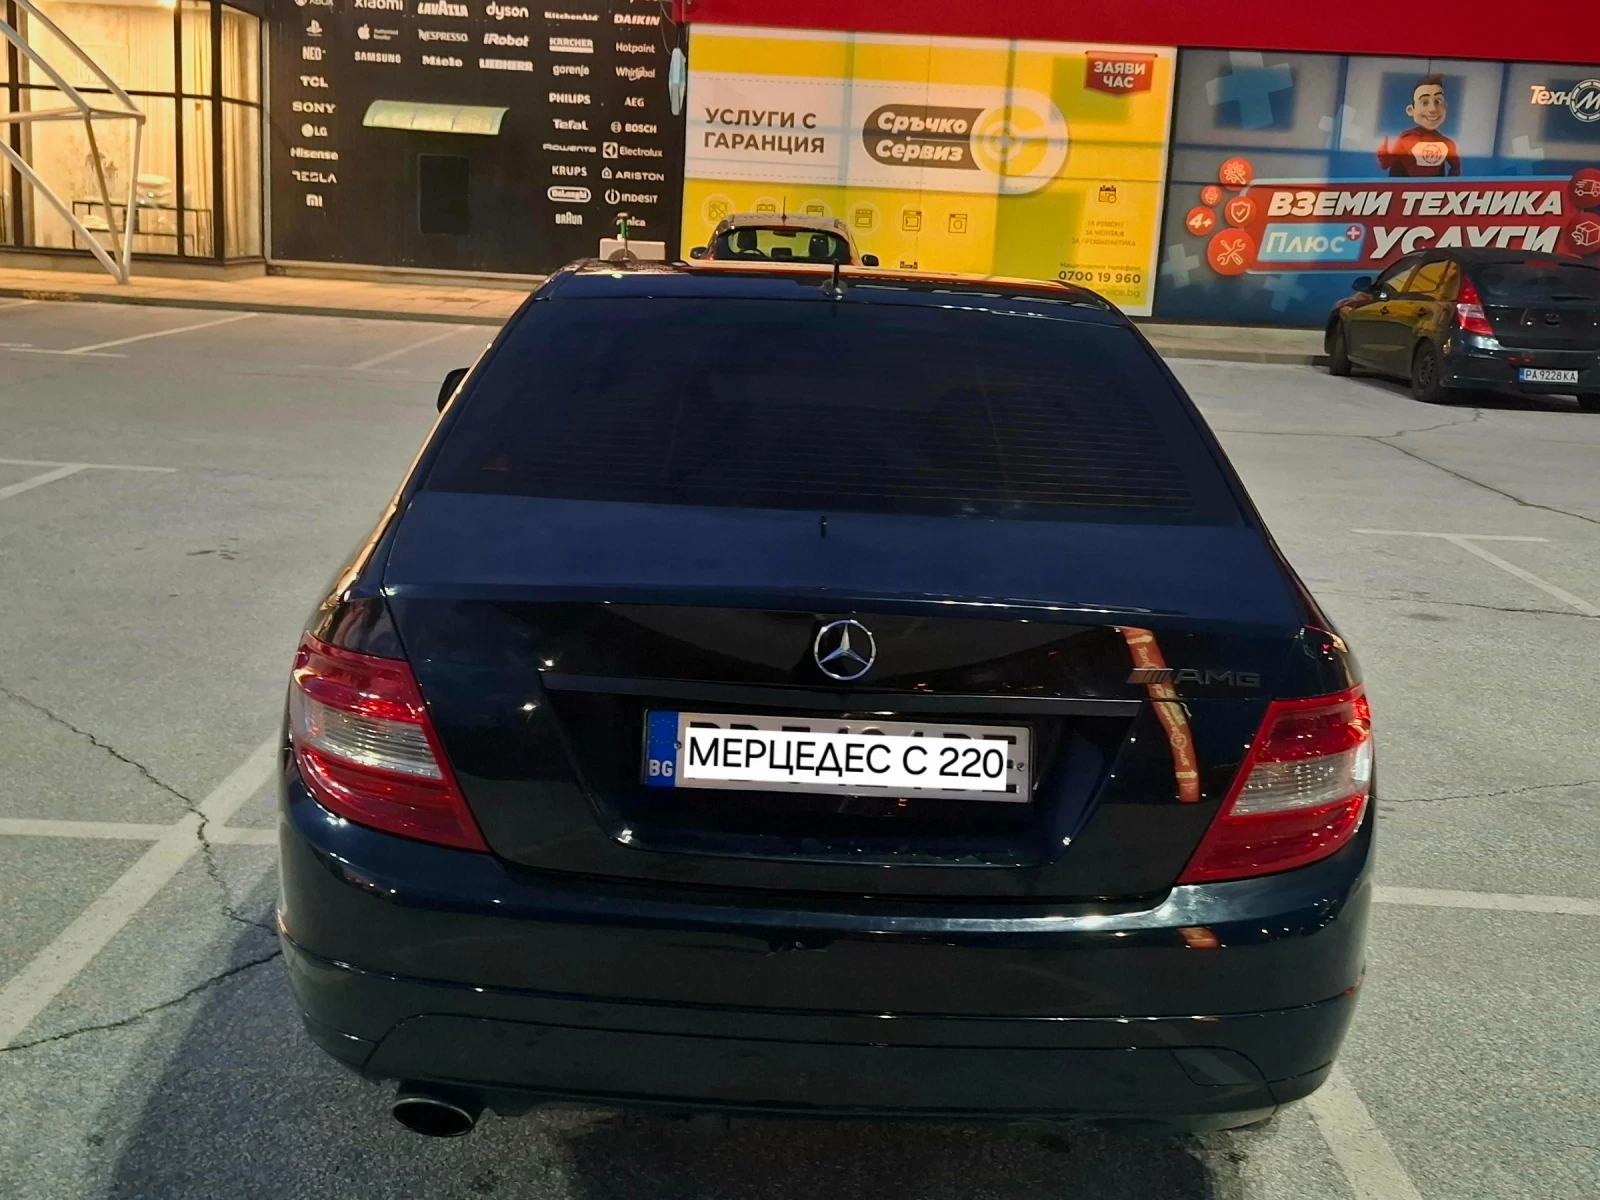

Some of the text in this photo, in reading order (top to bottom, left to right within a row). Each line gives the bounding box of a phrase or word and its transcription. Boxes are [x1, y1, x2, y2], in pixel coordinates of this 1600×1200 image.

[417, 1, 469, 17] LAVAZZA
[486, 2, 529, 20] dyson
[614, 14, 660, 26] DAIKIN
[484, 33, 529, 47] iRobot
[302, 46, 322, 61] NEO
[616, 42, 655, 54] Hotpoint
[354, 51, 401, 64] SAMSUNG
[422, 55, 463, 67] Miele
[479, 58, 533, 71] LIEBHERR
[553, 65, 590, 77] gorenje
[616, 66, 656, 81] Whirlpool
[1093, 61, 1146, 75] ЗАЯВИ
[300, 75, 328, 88] TCL
[1102, 75, 1135, 89] ЧАС
[549, 92, 591, 105] PHILIPS
[624, 97, 645, 107] AEG
[292, 101, 336, 114] SONY
[552, 118, 588, 131] Tefal
[704, 107, 817, 129] УСЛУГИ С
[877, 111, 968, 135] Сръчко
[314, 126, 328, 137] LG
[624, 123, 657, 134] BOSCH
[704, 131, 825, 155] ГАРАНЦИЯ
[290, 147, 339, 161] Hisense
[619, 146, 663, 157] Electrolux
[875, 139, 963, 162] Сервиз
[291, 170, 338, 184] TESLA
[551, 165, 588, 177] KRUPS
[615, 171, 665, 182] ARISTON
[1267, 190, 1562, 217] ВЗЕМИ ТЕХНИКА
[1189, 213, 1213, 229] 4+
[1369, 225, 1560, 259] УСЛУГИ
[1058, 270, 1141, 285] 0700 19 960
[1525, 370, 1576, 382] PA 9228 KA
[1173, 668, 1261, 688] AMG
[648, 758, 673, 778] BG
